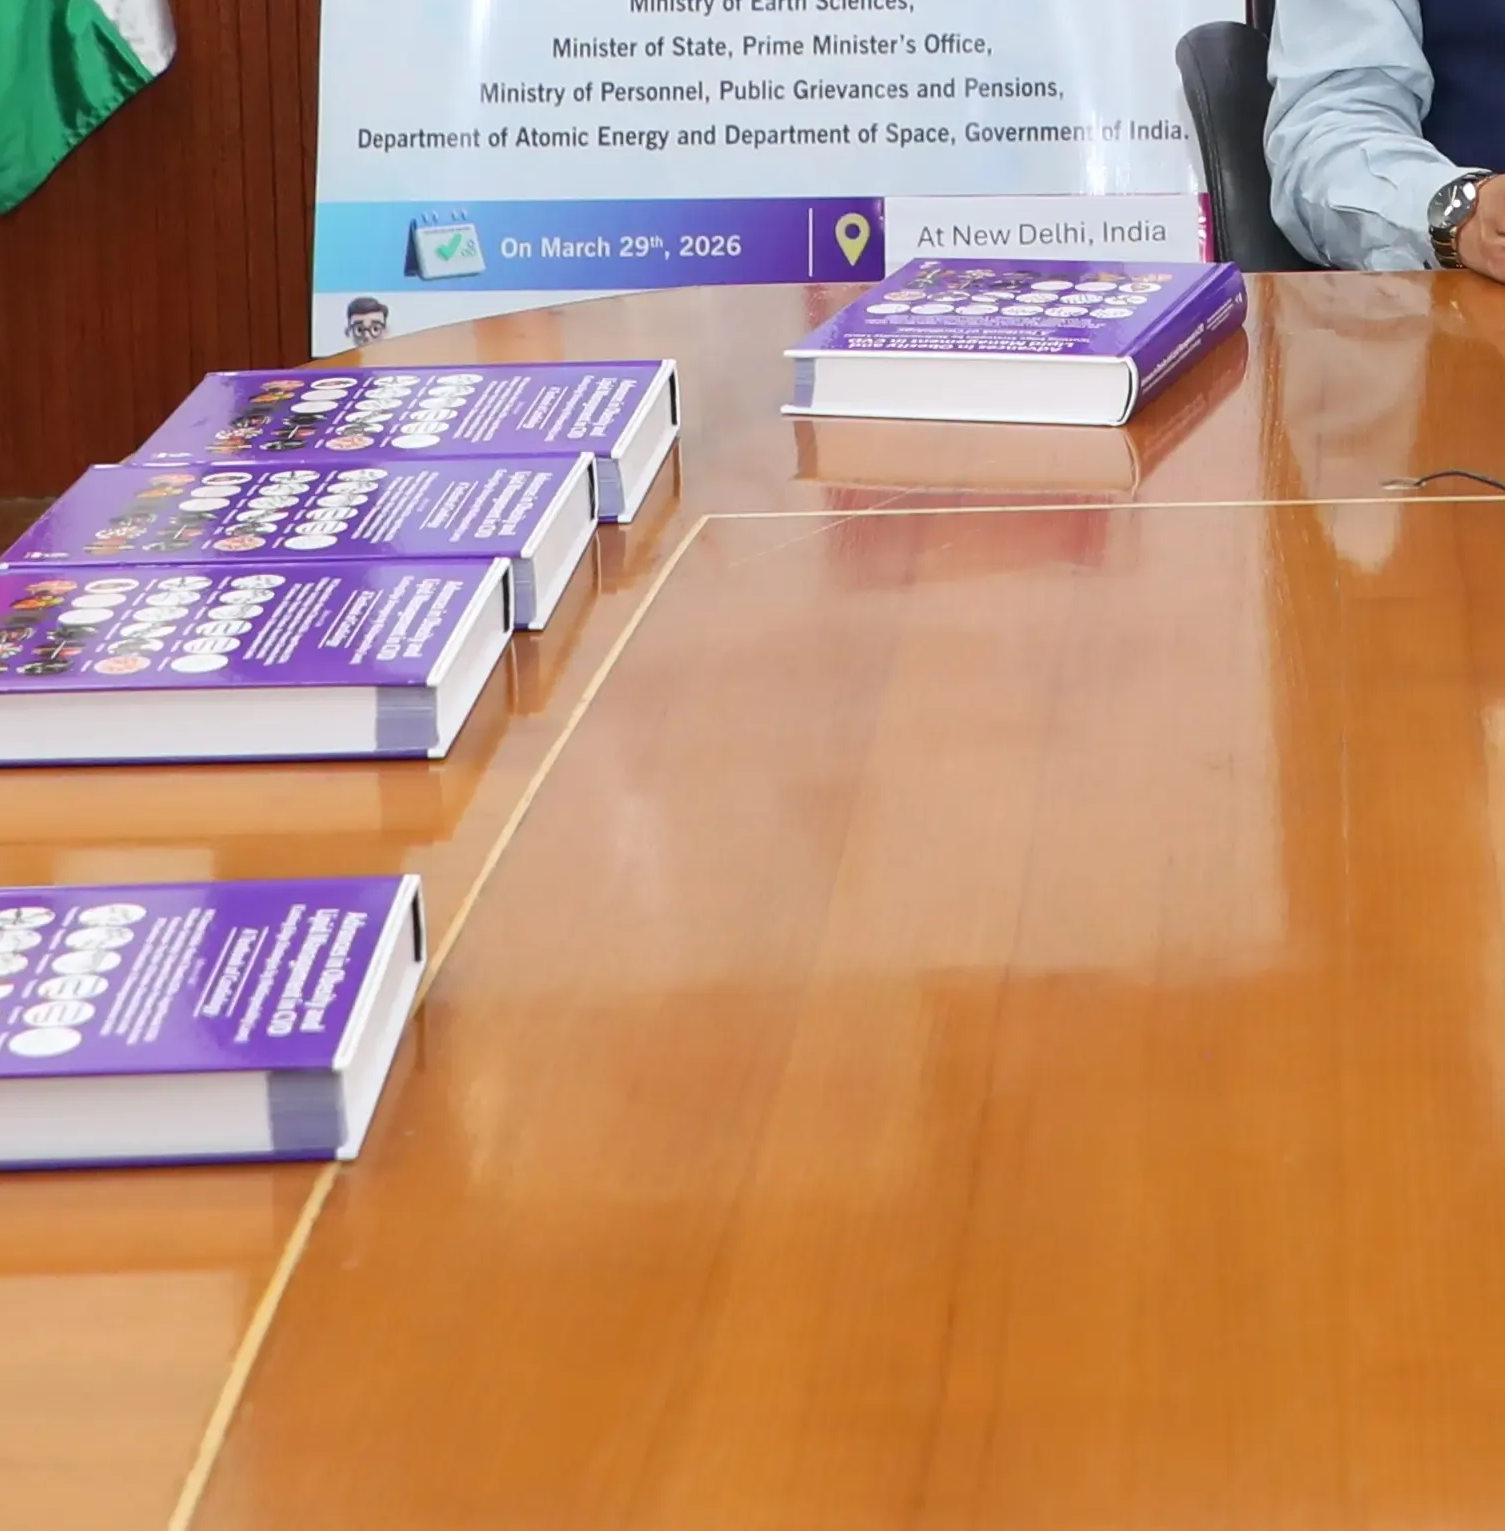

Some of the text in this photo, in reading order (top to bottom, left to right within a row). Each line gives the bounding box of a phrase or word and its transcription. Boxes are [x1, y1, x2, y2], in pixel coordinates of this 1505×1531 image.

[553, 33, 991, 58] Minister of State, Prime Minister's Office,
[481, 78, 1063, 106] Ministry of Personnel, Public Grievances and Pensions,
[359, 120, 1188, 152] Department of Atomic Energy and Department of Space, Government of India.
[918, 221, 1165, 247] At New Delhi, India
[501, 238, 532, 259] On
[541, 237, 611, 257] March
[680, 236, 741, 256] 2026
